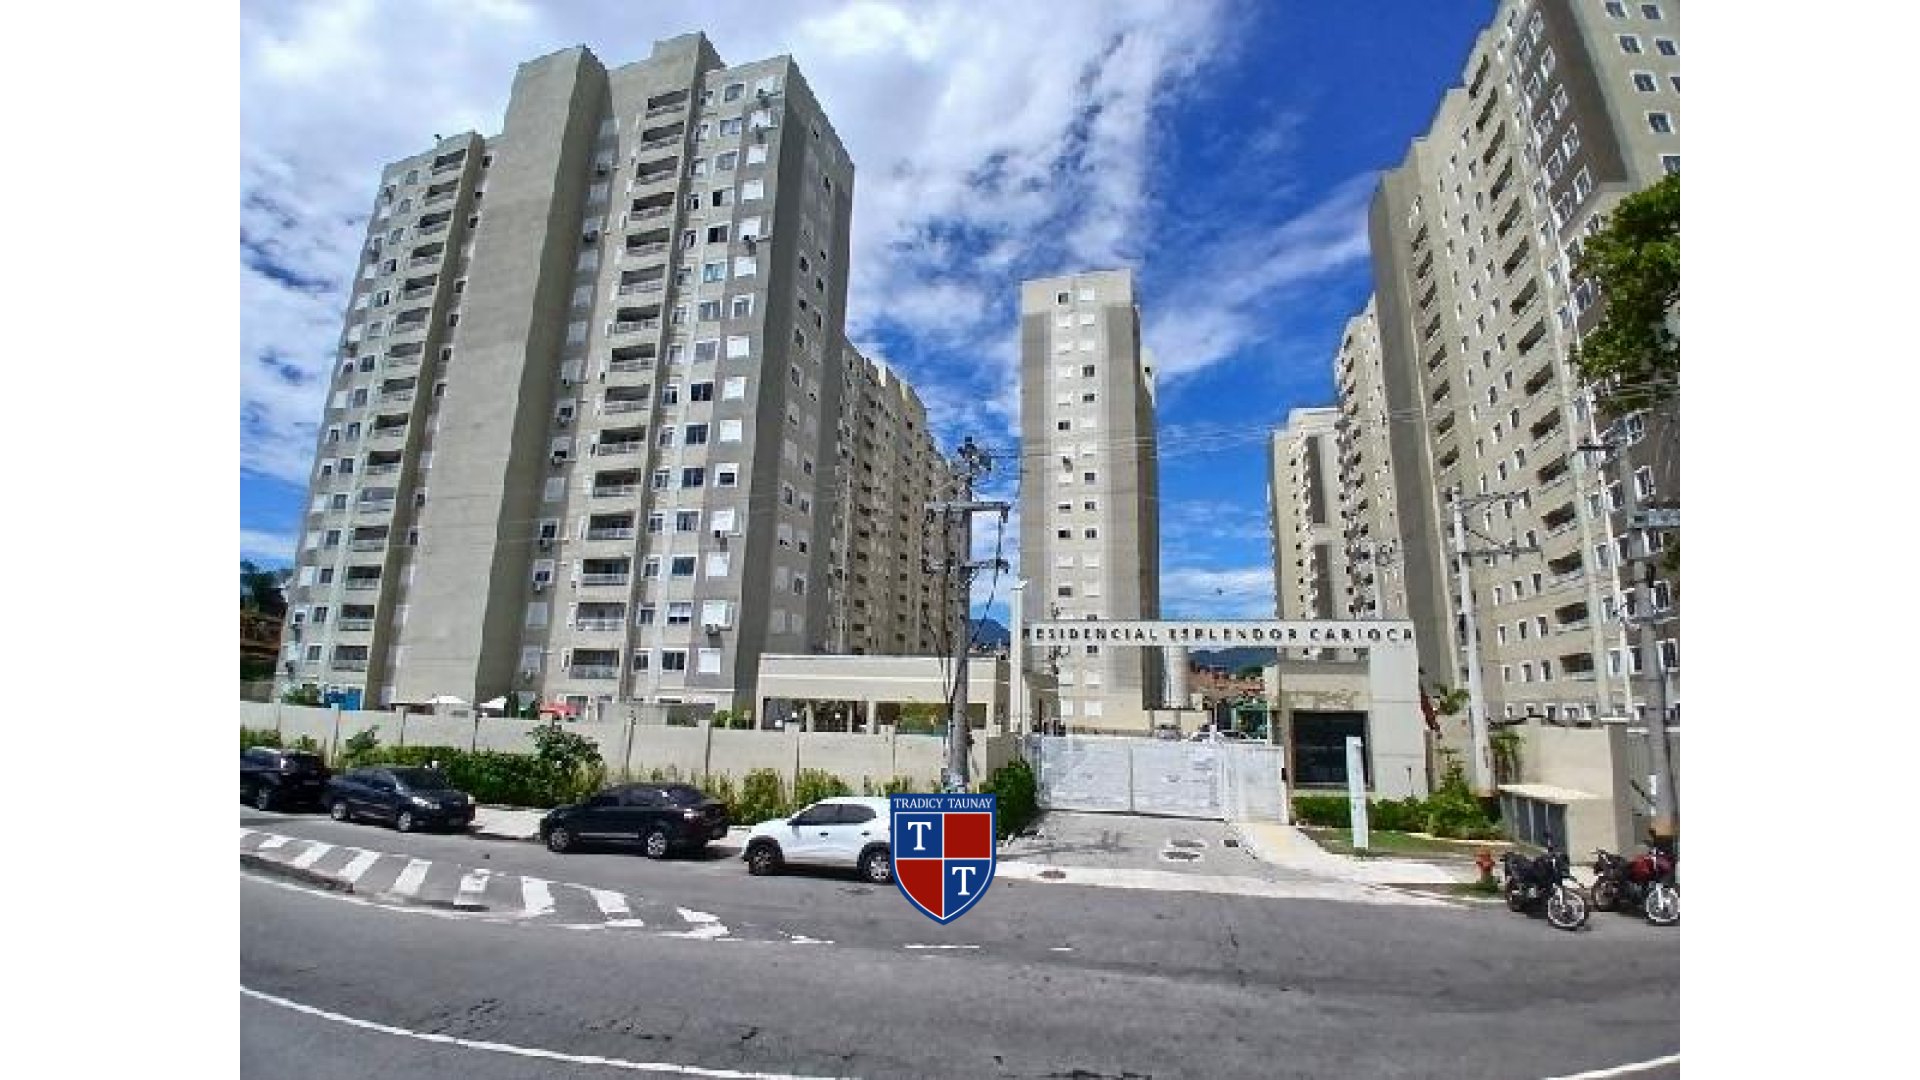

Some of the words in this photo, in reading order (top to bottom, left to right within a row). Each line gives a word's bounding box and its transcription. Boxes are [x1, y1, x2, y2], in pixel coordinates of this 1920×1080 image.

[1022, 628, 1158, 640] RESIDENCIAL
[1169, 628, 1297, 640] ESPLENDOR
[1310, 628, 1413, 641] CARIOCA
